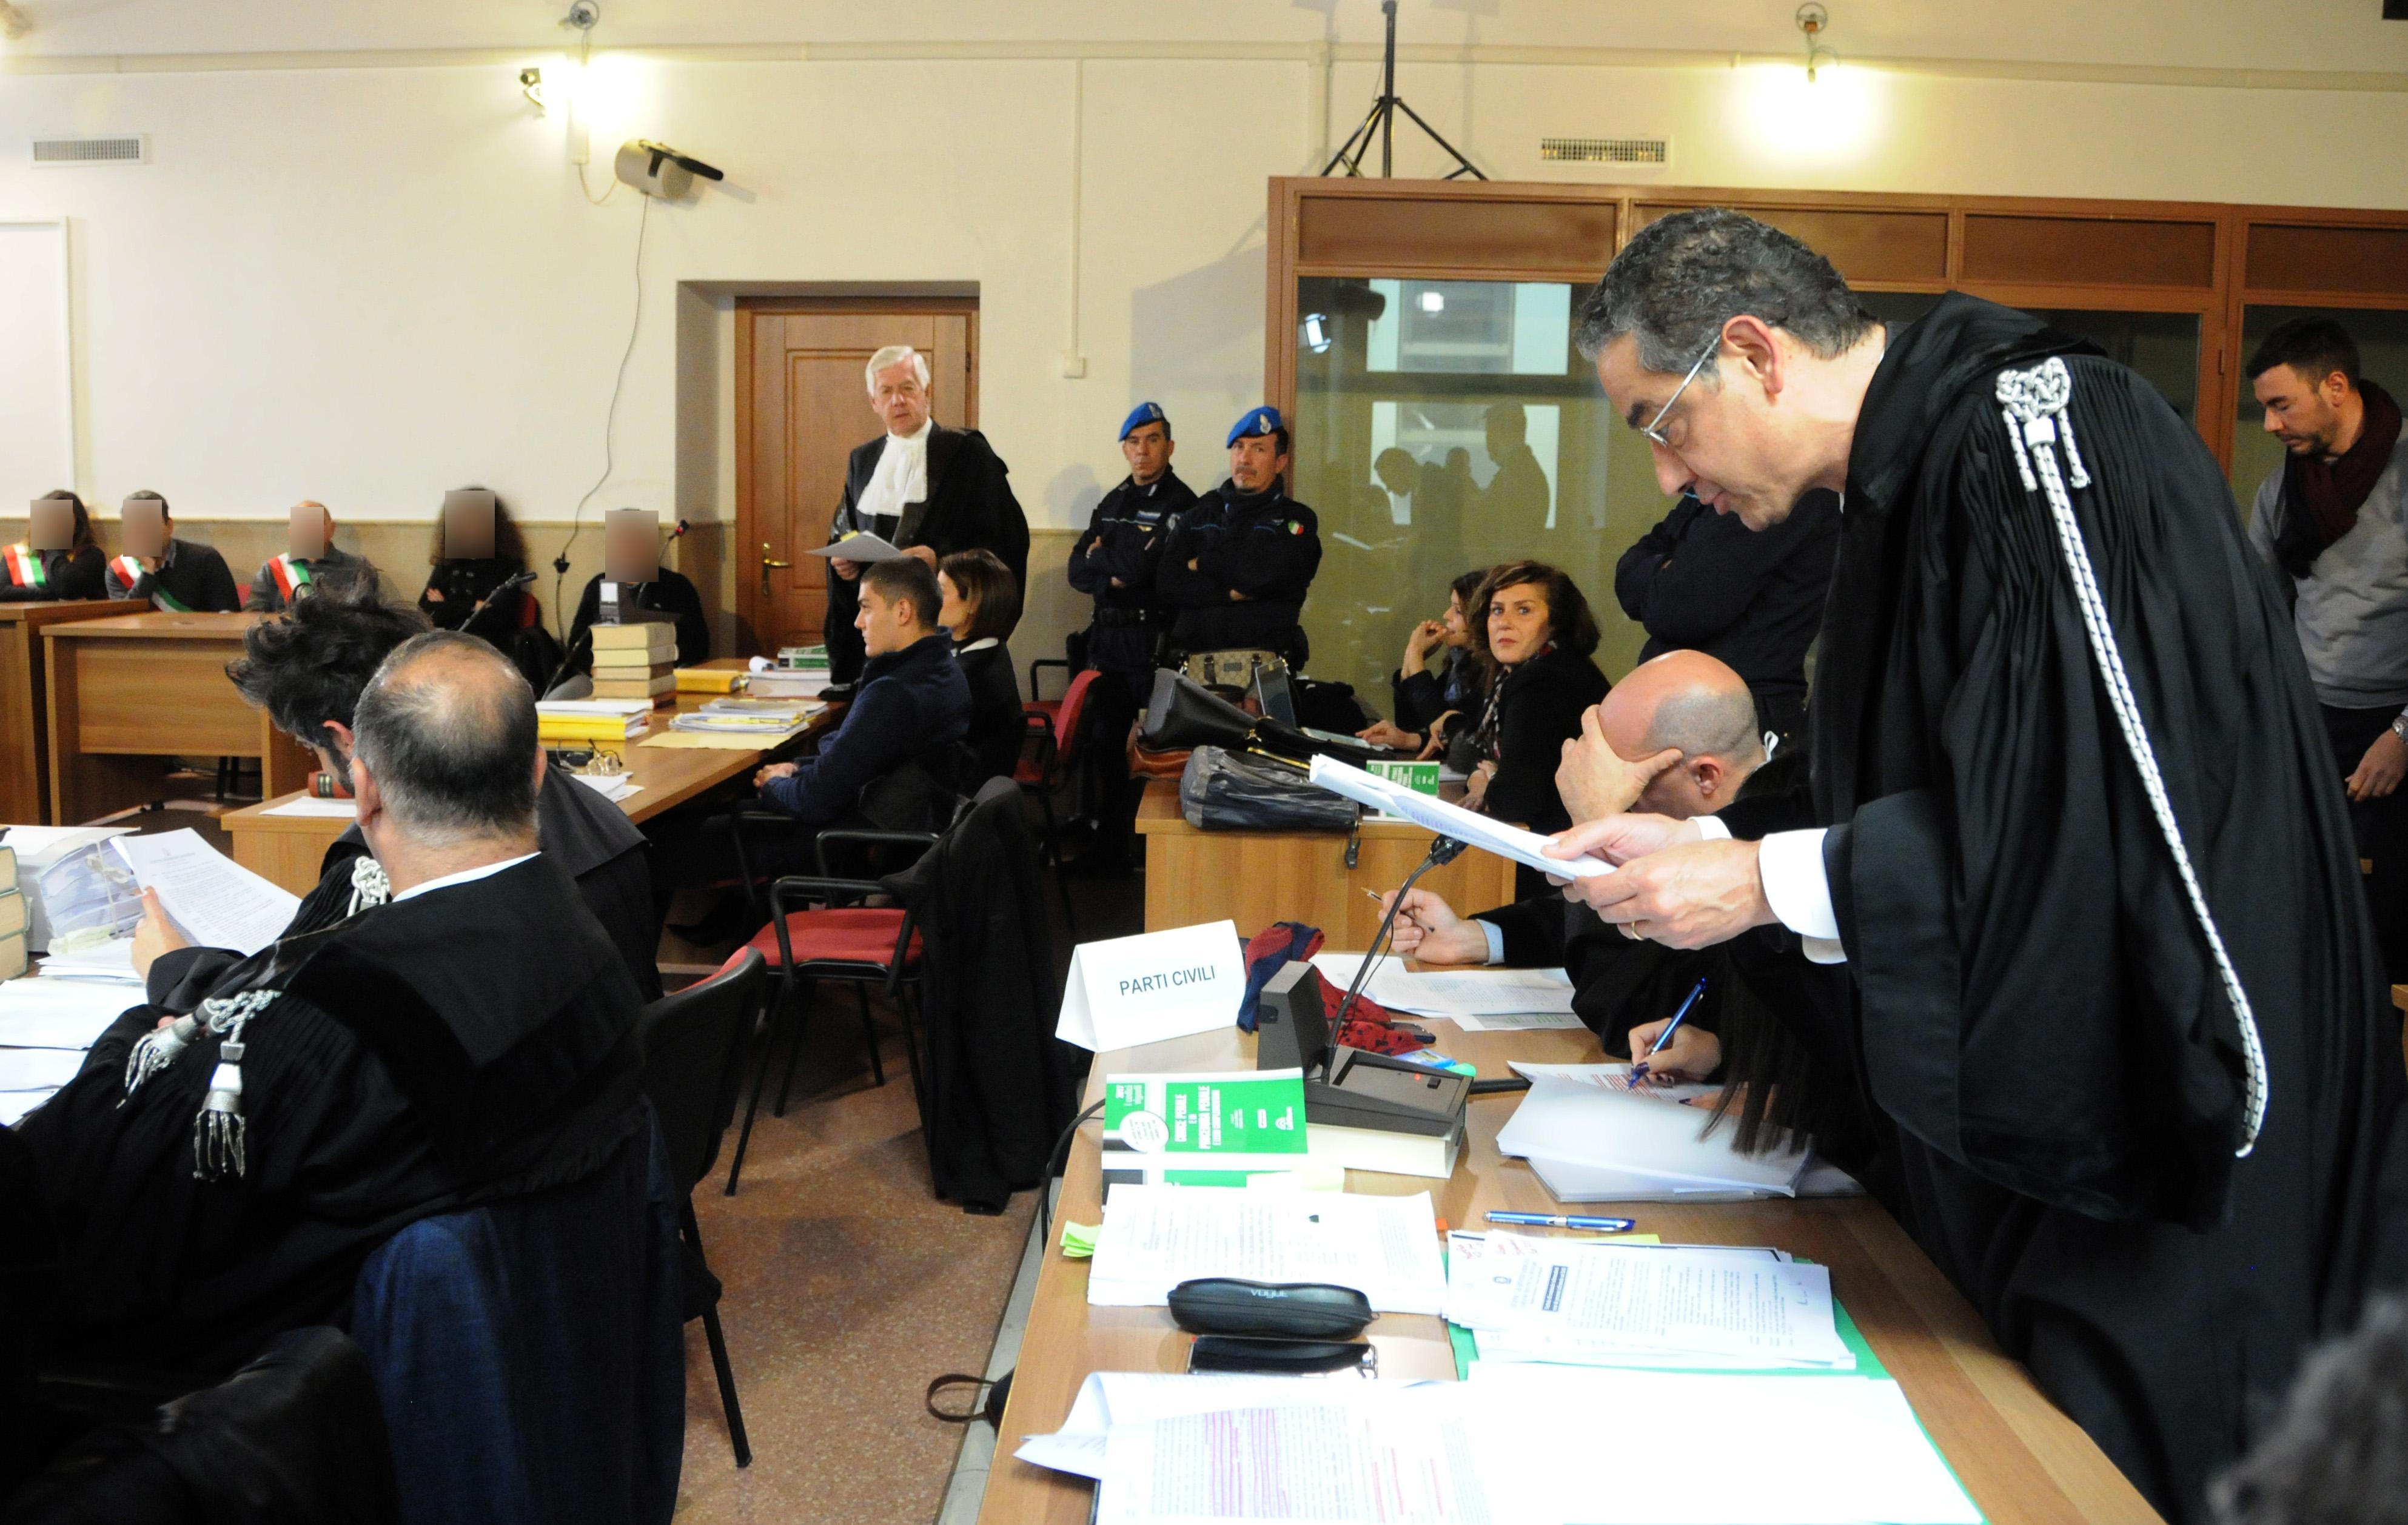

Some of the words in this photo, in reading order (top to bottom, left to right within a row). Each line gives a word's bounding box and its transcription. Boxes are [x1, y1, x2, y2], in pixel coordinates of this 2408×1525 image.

[1119, 973, 1168, 996] PARTI
[1172, 965, 1215, 986] CIVILI
[1175, 1094, 1187, 1119] PENALE
[1198, 1085, 1210, 1111] PENALE
[1175, 1119, 1187, 1142] CODICE
[1198, 1112, 1211, 1149] PROCEDURA
